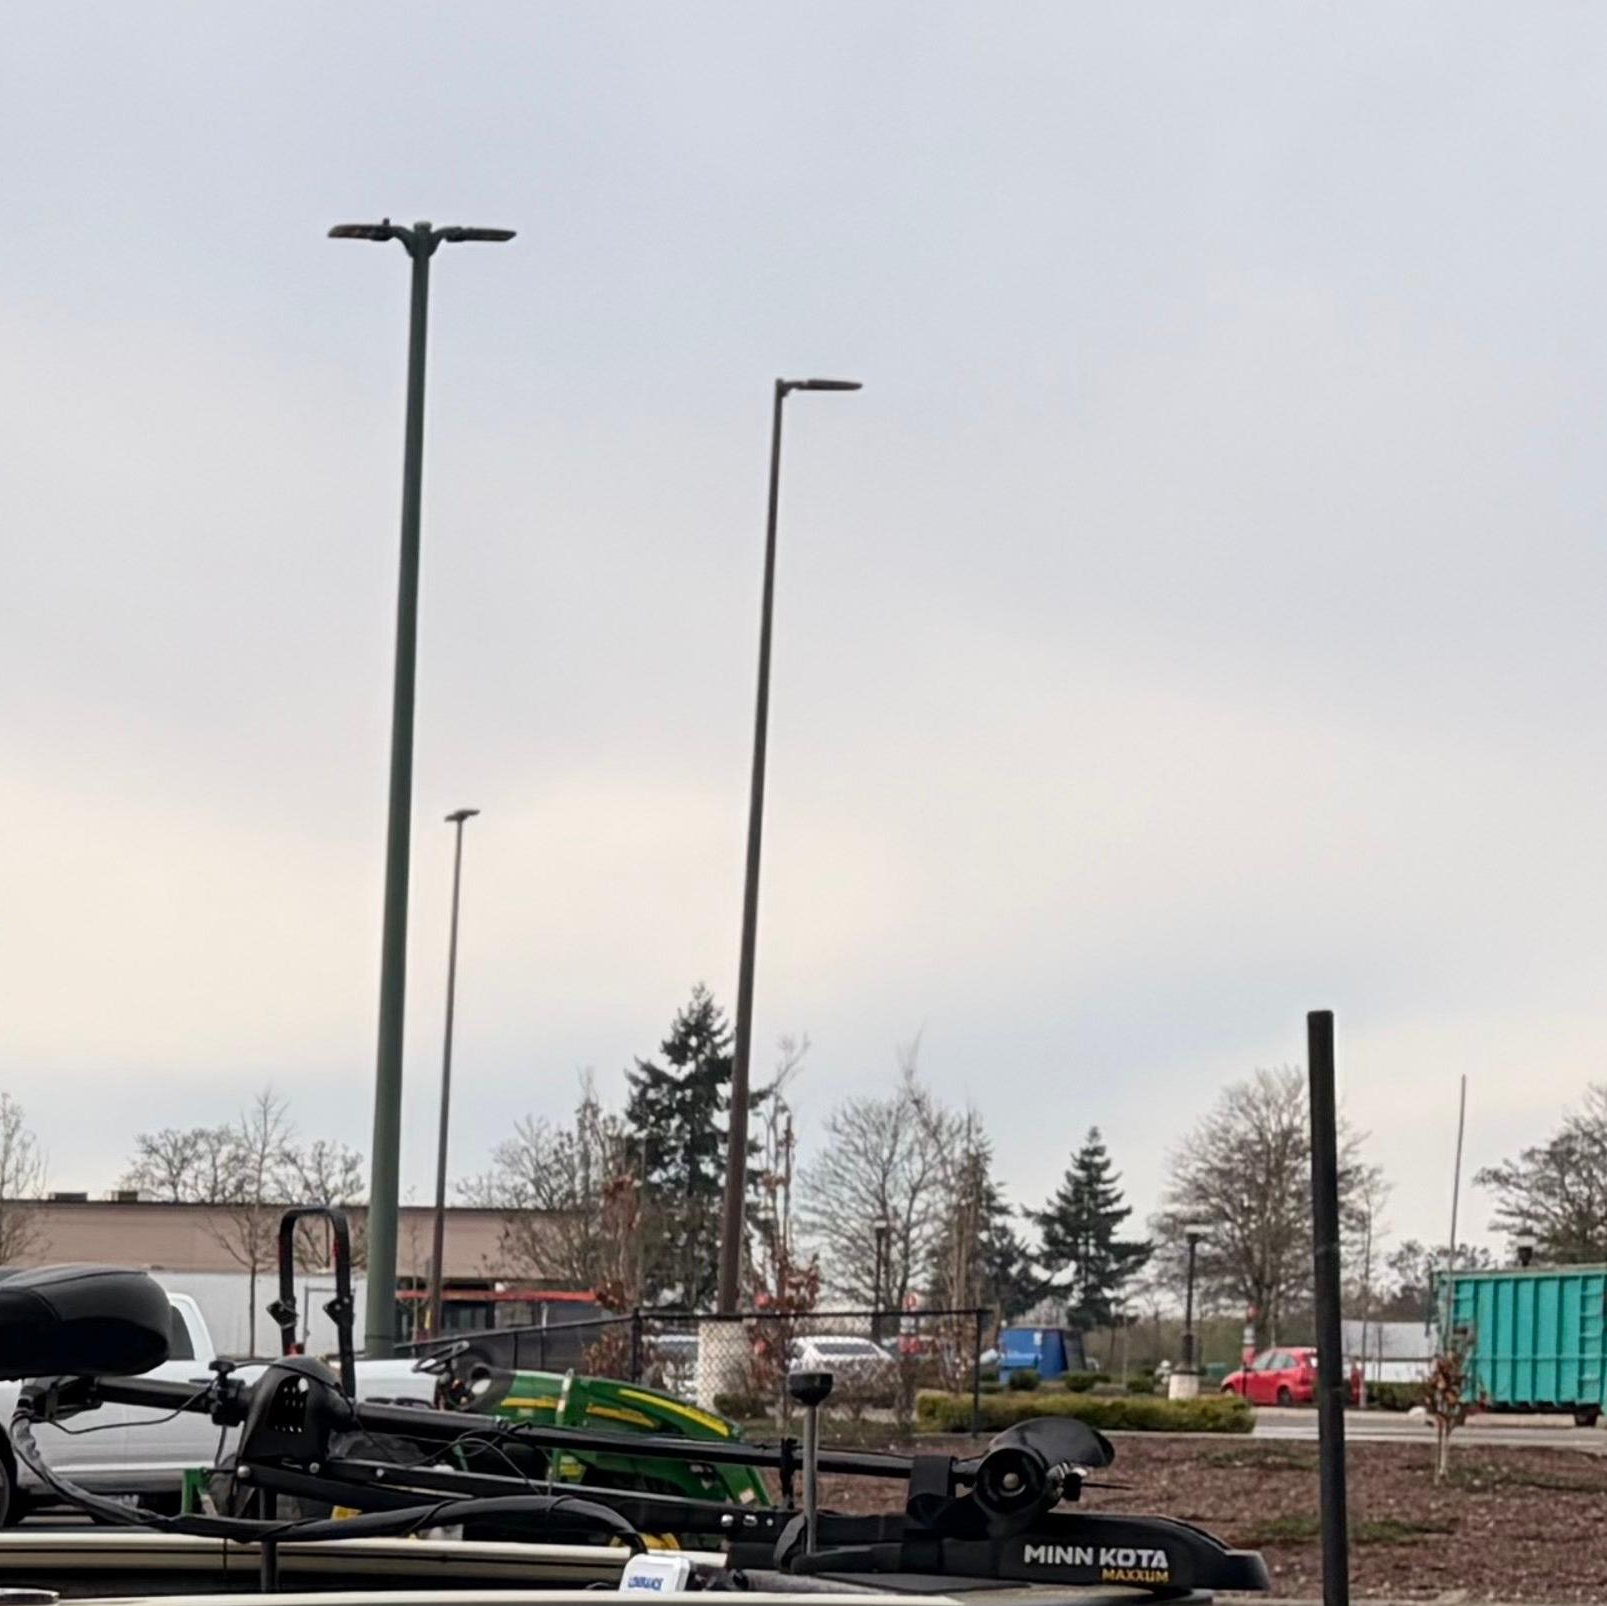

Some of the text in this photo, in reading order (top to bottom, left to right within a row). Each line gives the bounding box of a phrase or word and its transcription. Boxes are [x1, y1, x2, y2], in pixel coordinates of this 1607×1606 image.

[1024, 1544, 1169, 1568] MINN KOTA
[1101, 1568, 1169, 1582] MAXXUM
